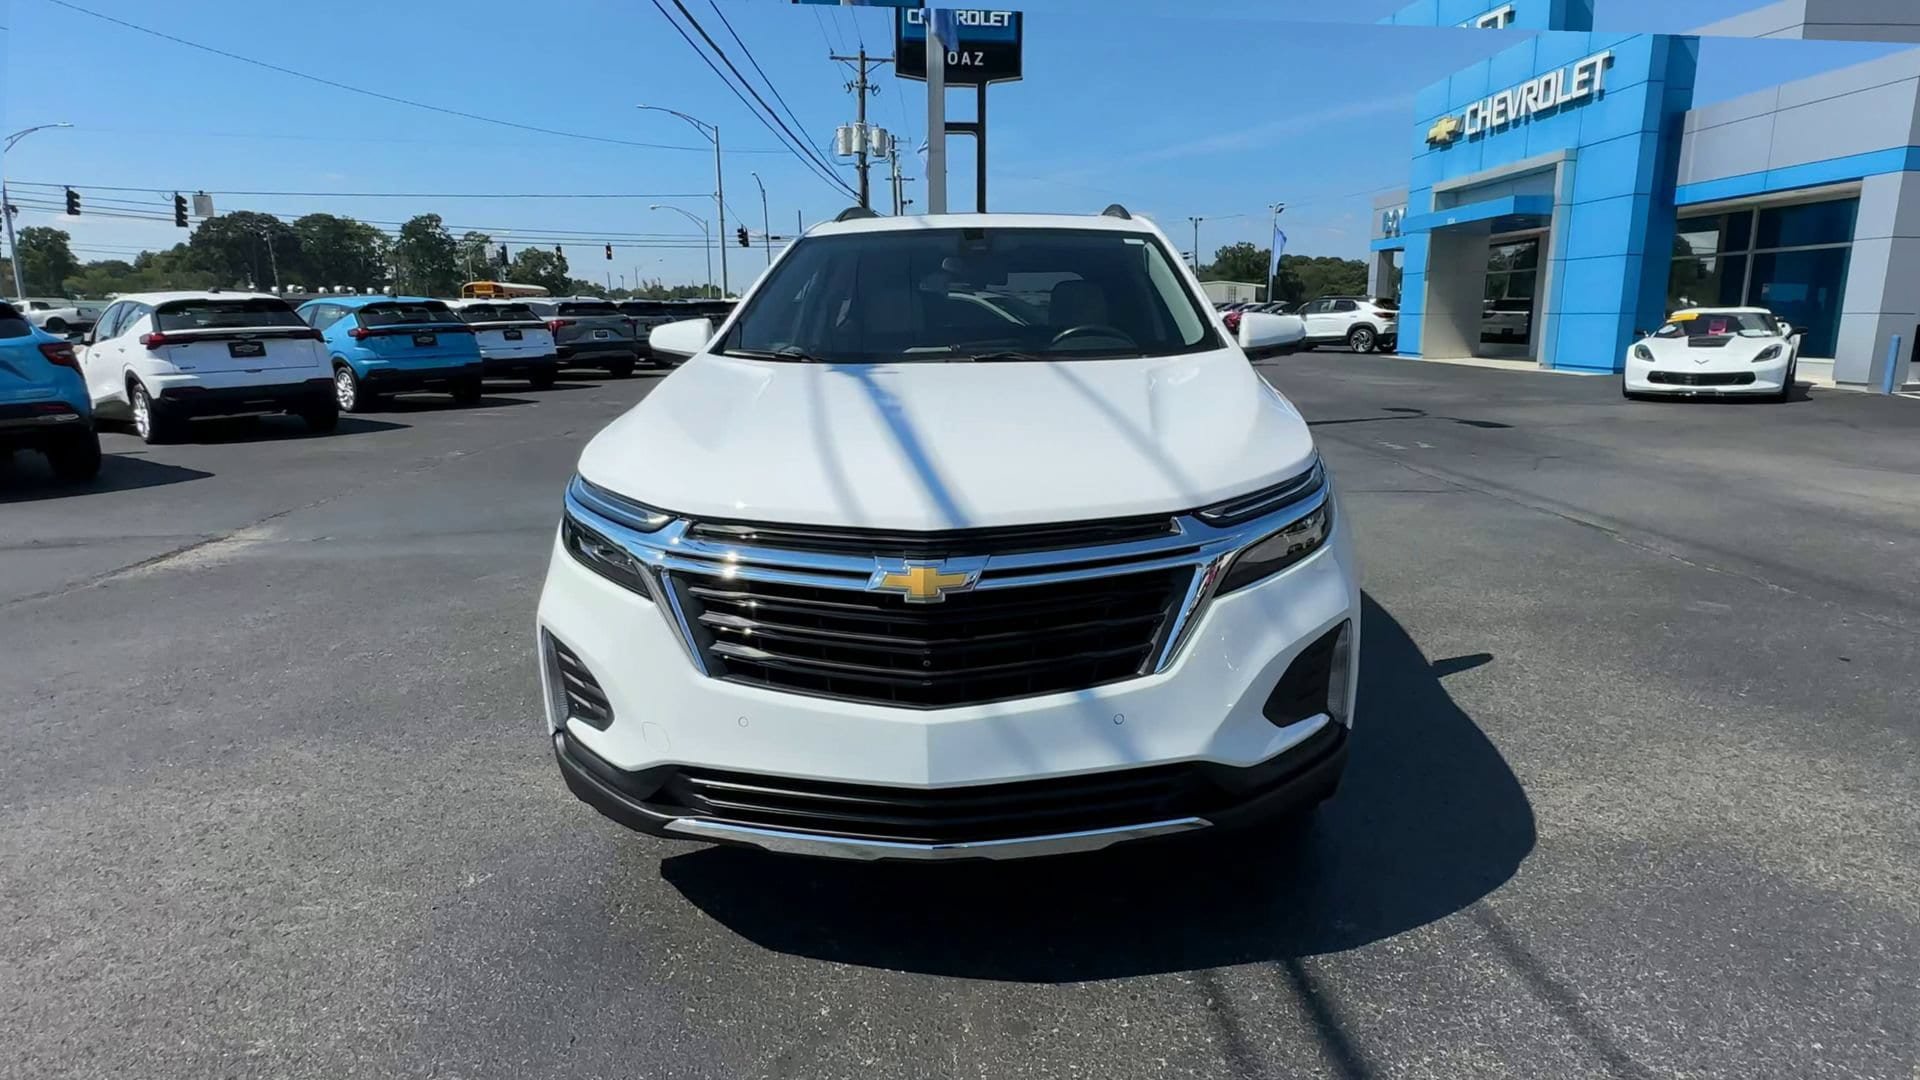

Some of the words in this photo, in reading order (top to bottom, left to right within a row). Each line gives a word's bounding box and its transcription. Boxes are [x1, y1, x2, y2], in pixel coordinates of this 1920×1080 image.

[907, 9, 1012, 27] CROLET
[947, 51, 985, 66] OAZ
[1465, 50, 1612, 135] CHEVROLET
